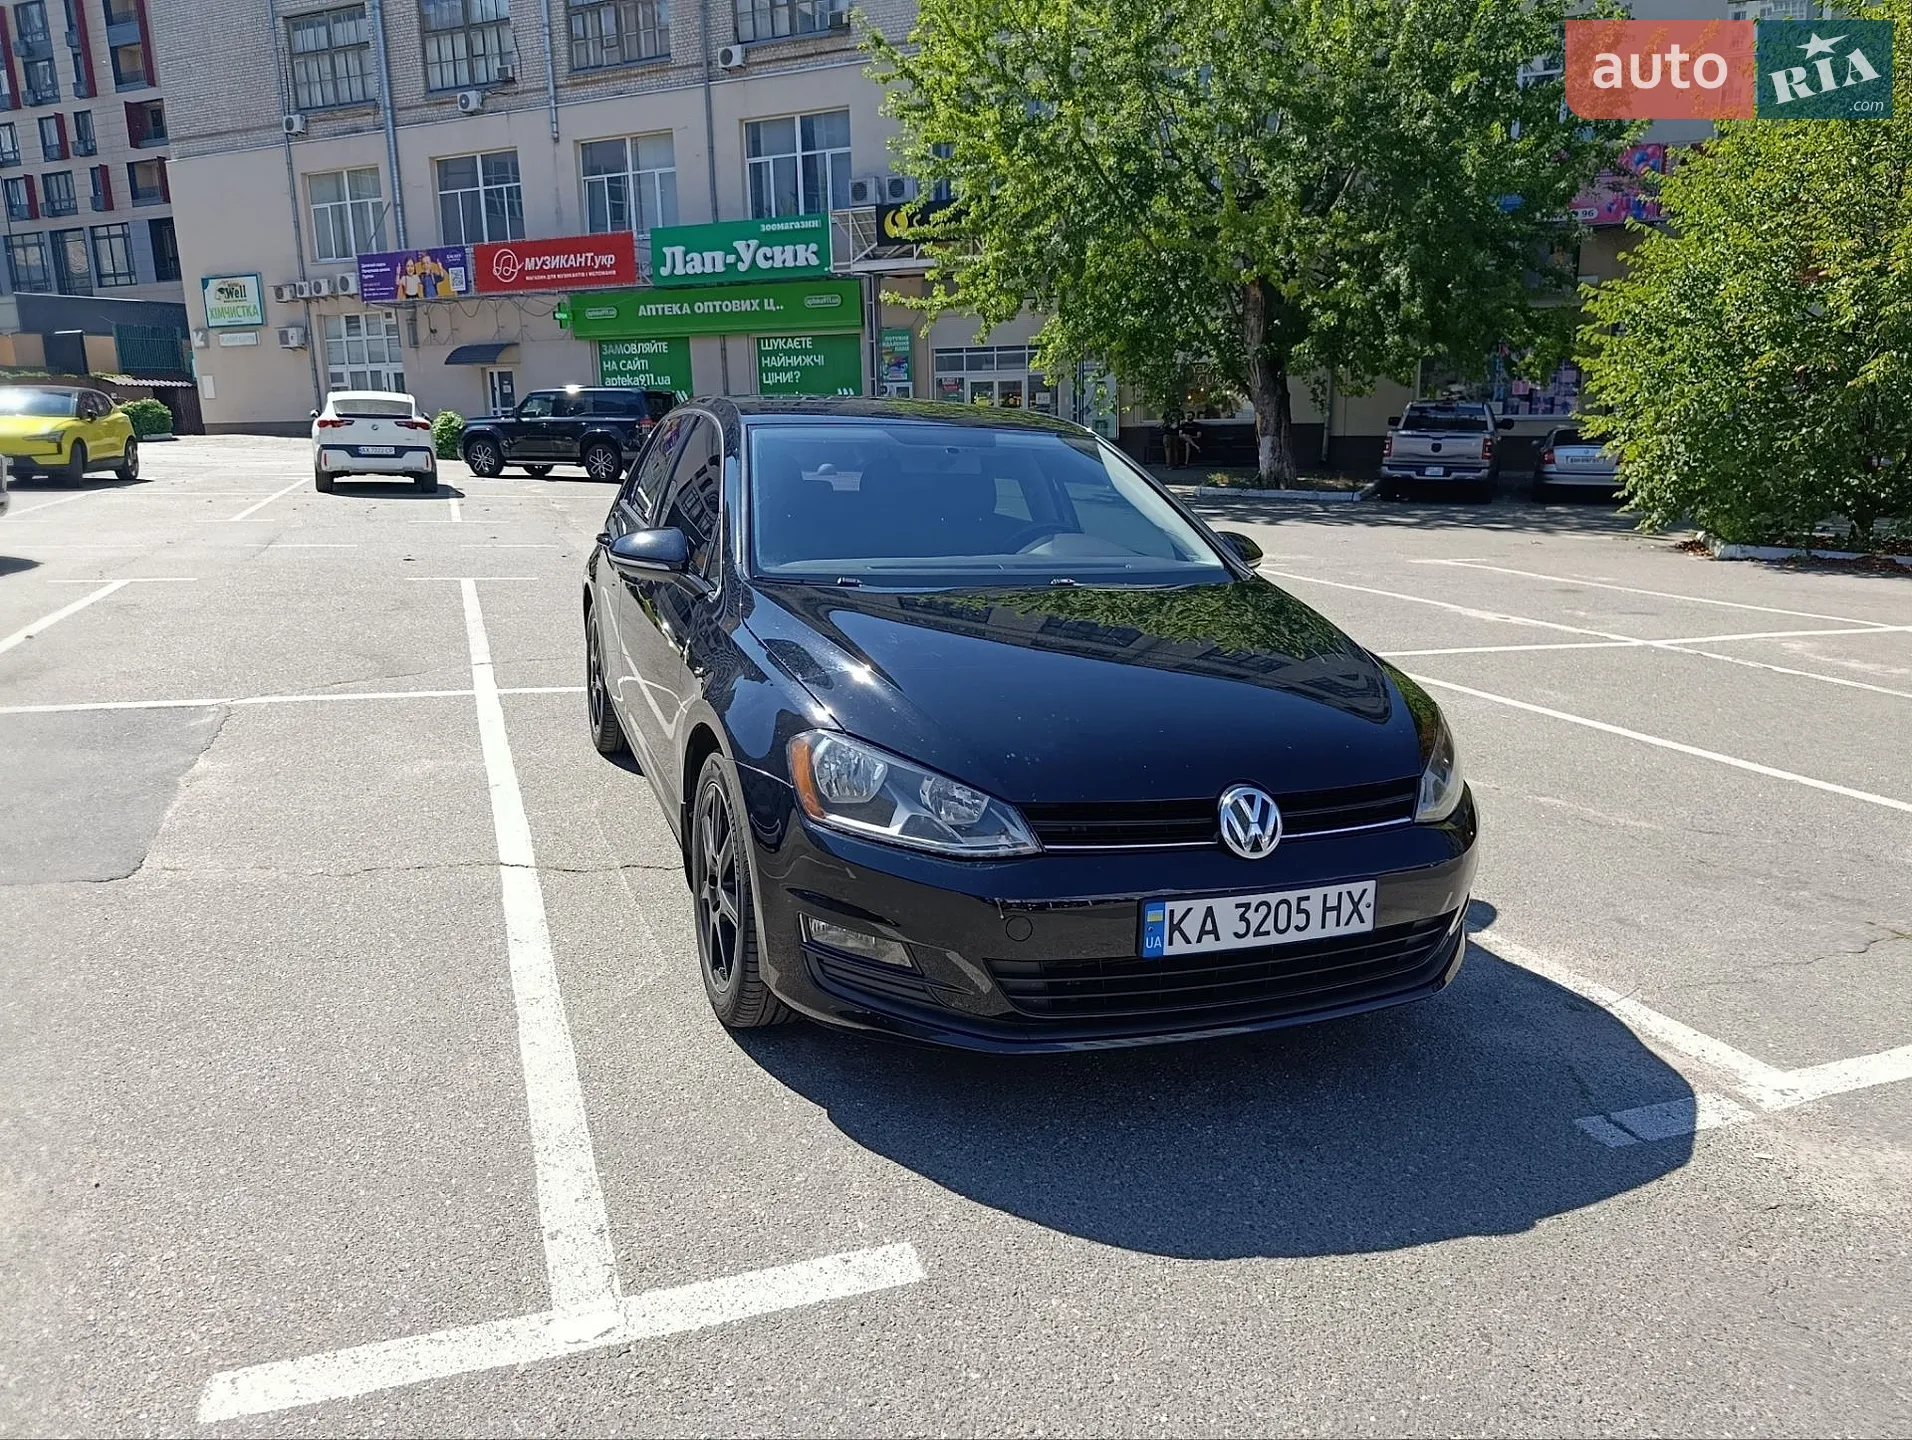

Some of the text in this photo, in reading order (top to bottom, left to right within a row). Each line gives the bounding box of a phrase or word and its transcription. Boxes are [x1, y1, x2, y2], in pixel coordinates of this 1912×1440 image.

[760, 219, 820, 232] зоомагазин
[525, 252, 616, 271] МУЗИКАНТ.укр
[660, 239, 820, 277] Лап-Усик
[224, 284, 248, 299] Well
[208, 304, 260, 320] ХІМЧИСТКА
[638, 303, 691, 316] АПТЕКА
[694, 299, 760, 313] ОПТОВИХ
[601, 340, 668, 355] ЗАМОВЛЯЙТЕ
[760, 337, 813, 350] ШУКАЄТЕ
[603, 357, 648, 371] НА САЙТІ
[761, 352, 824, 367] НАЙНИЖЧІ
[605, 373, 671, 387] apteka911.ua
[762, 371, 801, 386] ЦІНИ!?
[1168, 888, 1368, 946] KA 3205 HX
[1145, 936, 1162, 949] UA
